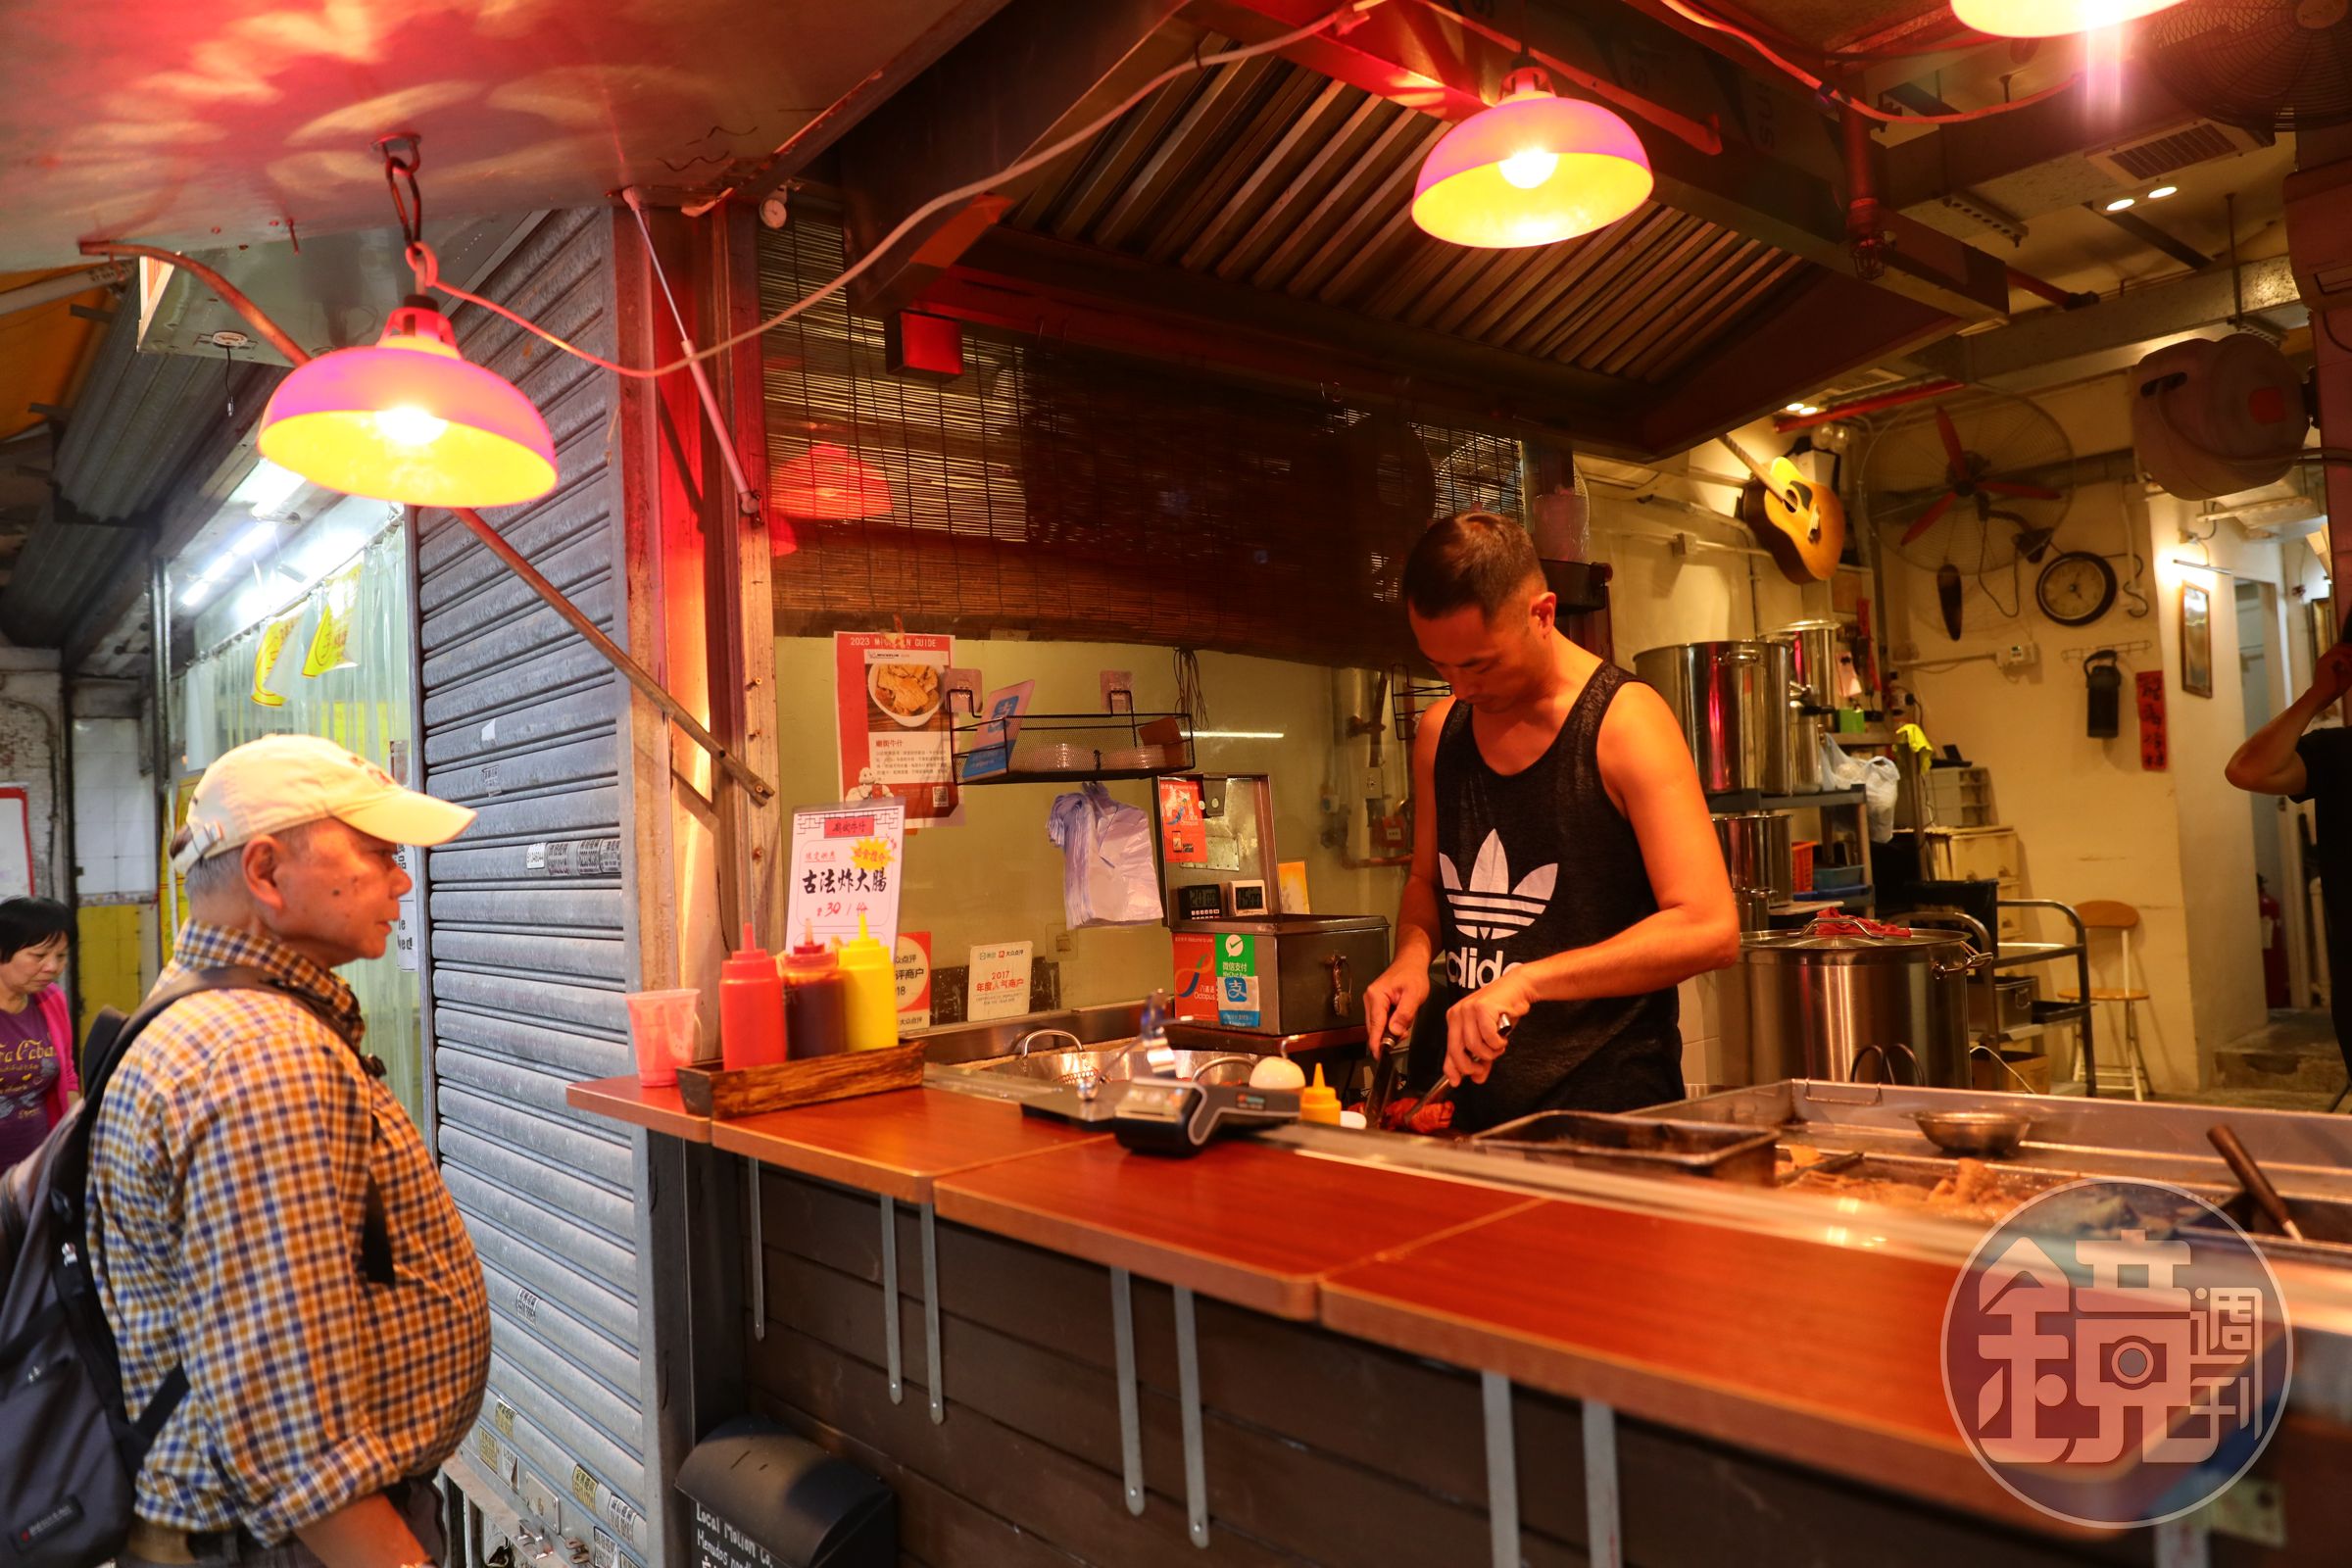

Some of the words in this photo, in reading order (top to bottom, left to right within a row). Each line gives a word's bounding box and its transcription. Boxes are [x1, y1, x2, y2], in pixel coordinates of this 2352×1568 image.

[850, 637, 870, 646] 2023
[802, 866, 888, 894] 古法炸大腸
[895, 955, 916, 964] 众点评
[895, 968, 924, 981] 评商户
[991, 970, 1010, 981] 2017
[696, 1501, 720, 1535] Local
